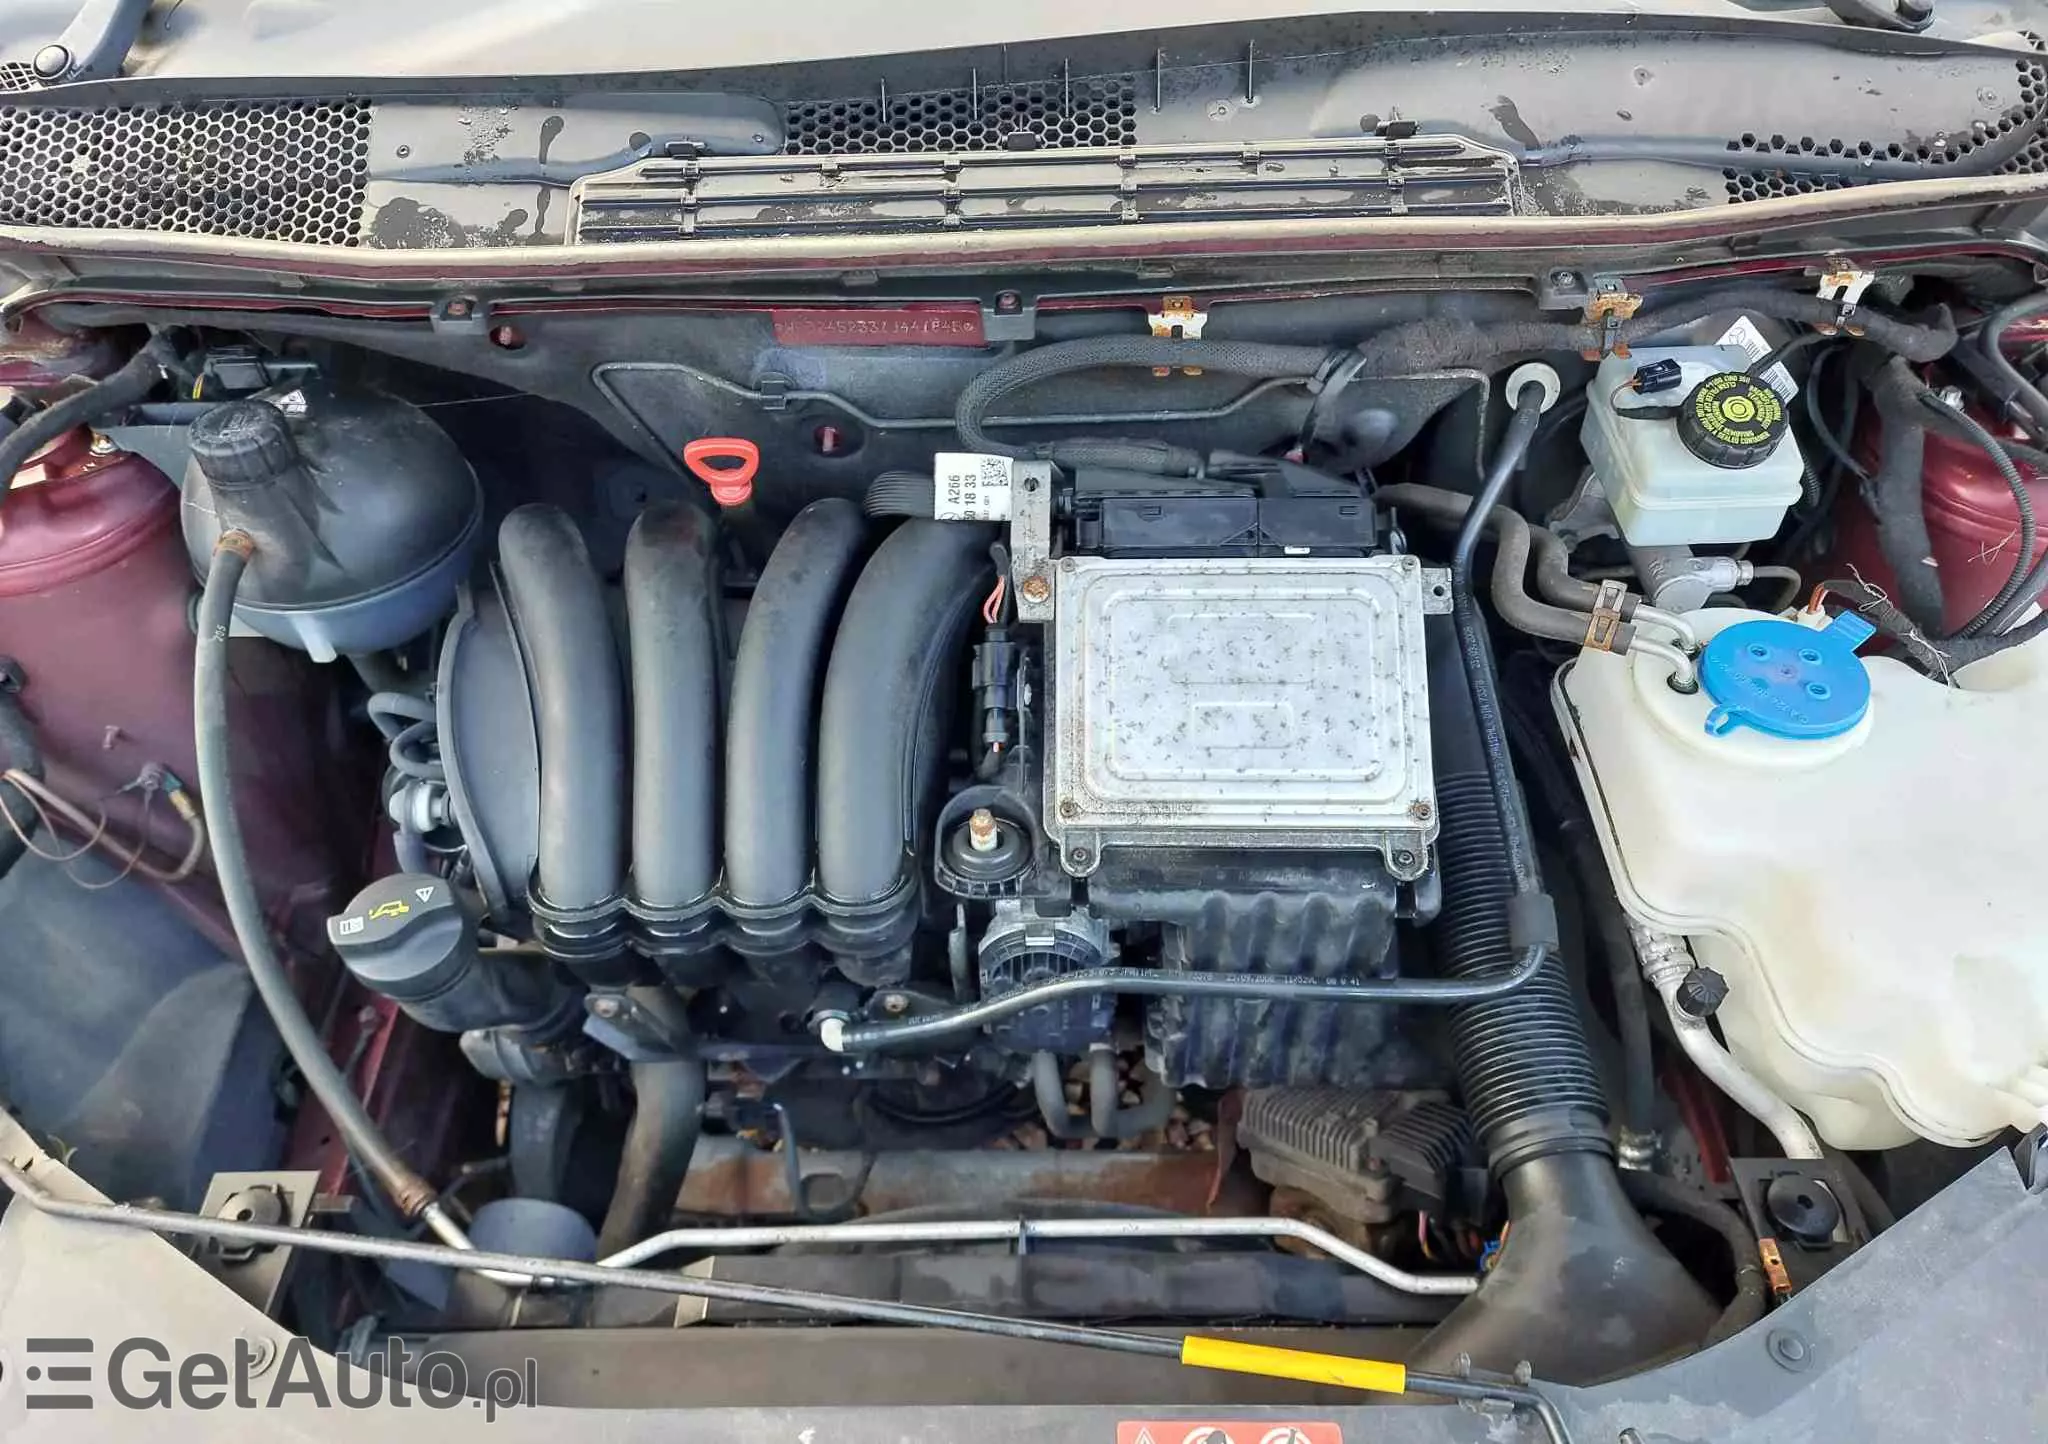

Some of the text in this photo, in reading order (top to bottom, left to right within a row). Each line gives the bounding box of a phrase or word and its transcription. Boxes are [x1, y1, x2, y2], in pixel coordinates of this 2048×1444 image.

[964, 474, 977, 488] 33
[947, 474, 960, 504] A266
[963, 492, 977, 506] 18
